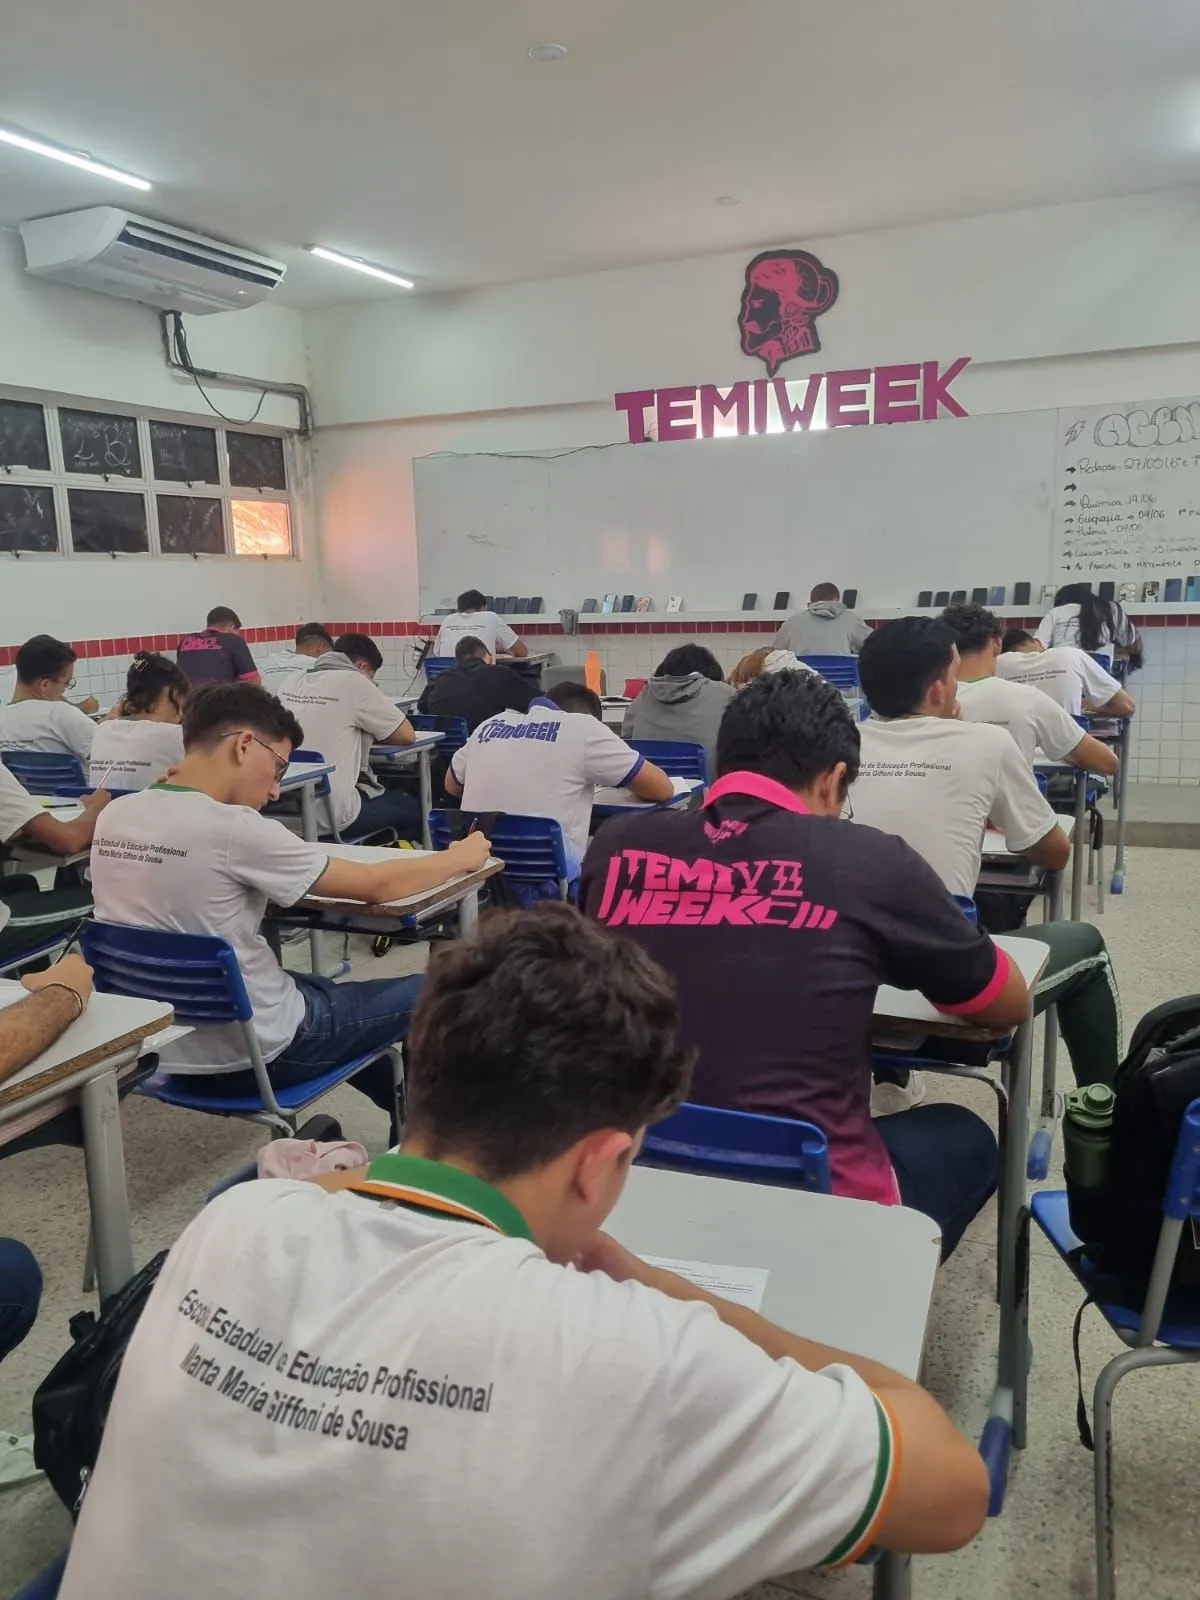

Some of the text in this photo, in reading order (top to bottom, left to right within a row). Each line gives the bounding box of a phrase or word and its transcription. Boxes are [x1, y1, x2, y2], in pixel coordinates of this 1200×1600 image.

[614, 356, 972, 445] TEMIWEEK
[908, 761, 952, 771] Profissional
[903, 769, 926, 777] Sousa
[150, 844, 188, 857] Profissional
[144, 854, 163, 864] Sousa
[206, 1307, 284, 1367] Estadual
[286, 1350, 369, 1397] Educação
[370, 1366, 494, 1414] Profissional
[217, 1365, 270, 1413] Maria
[321, 1404, 344, 1437] de
[346, 1409, 410, 1452] Sousa
